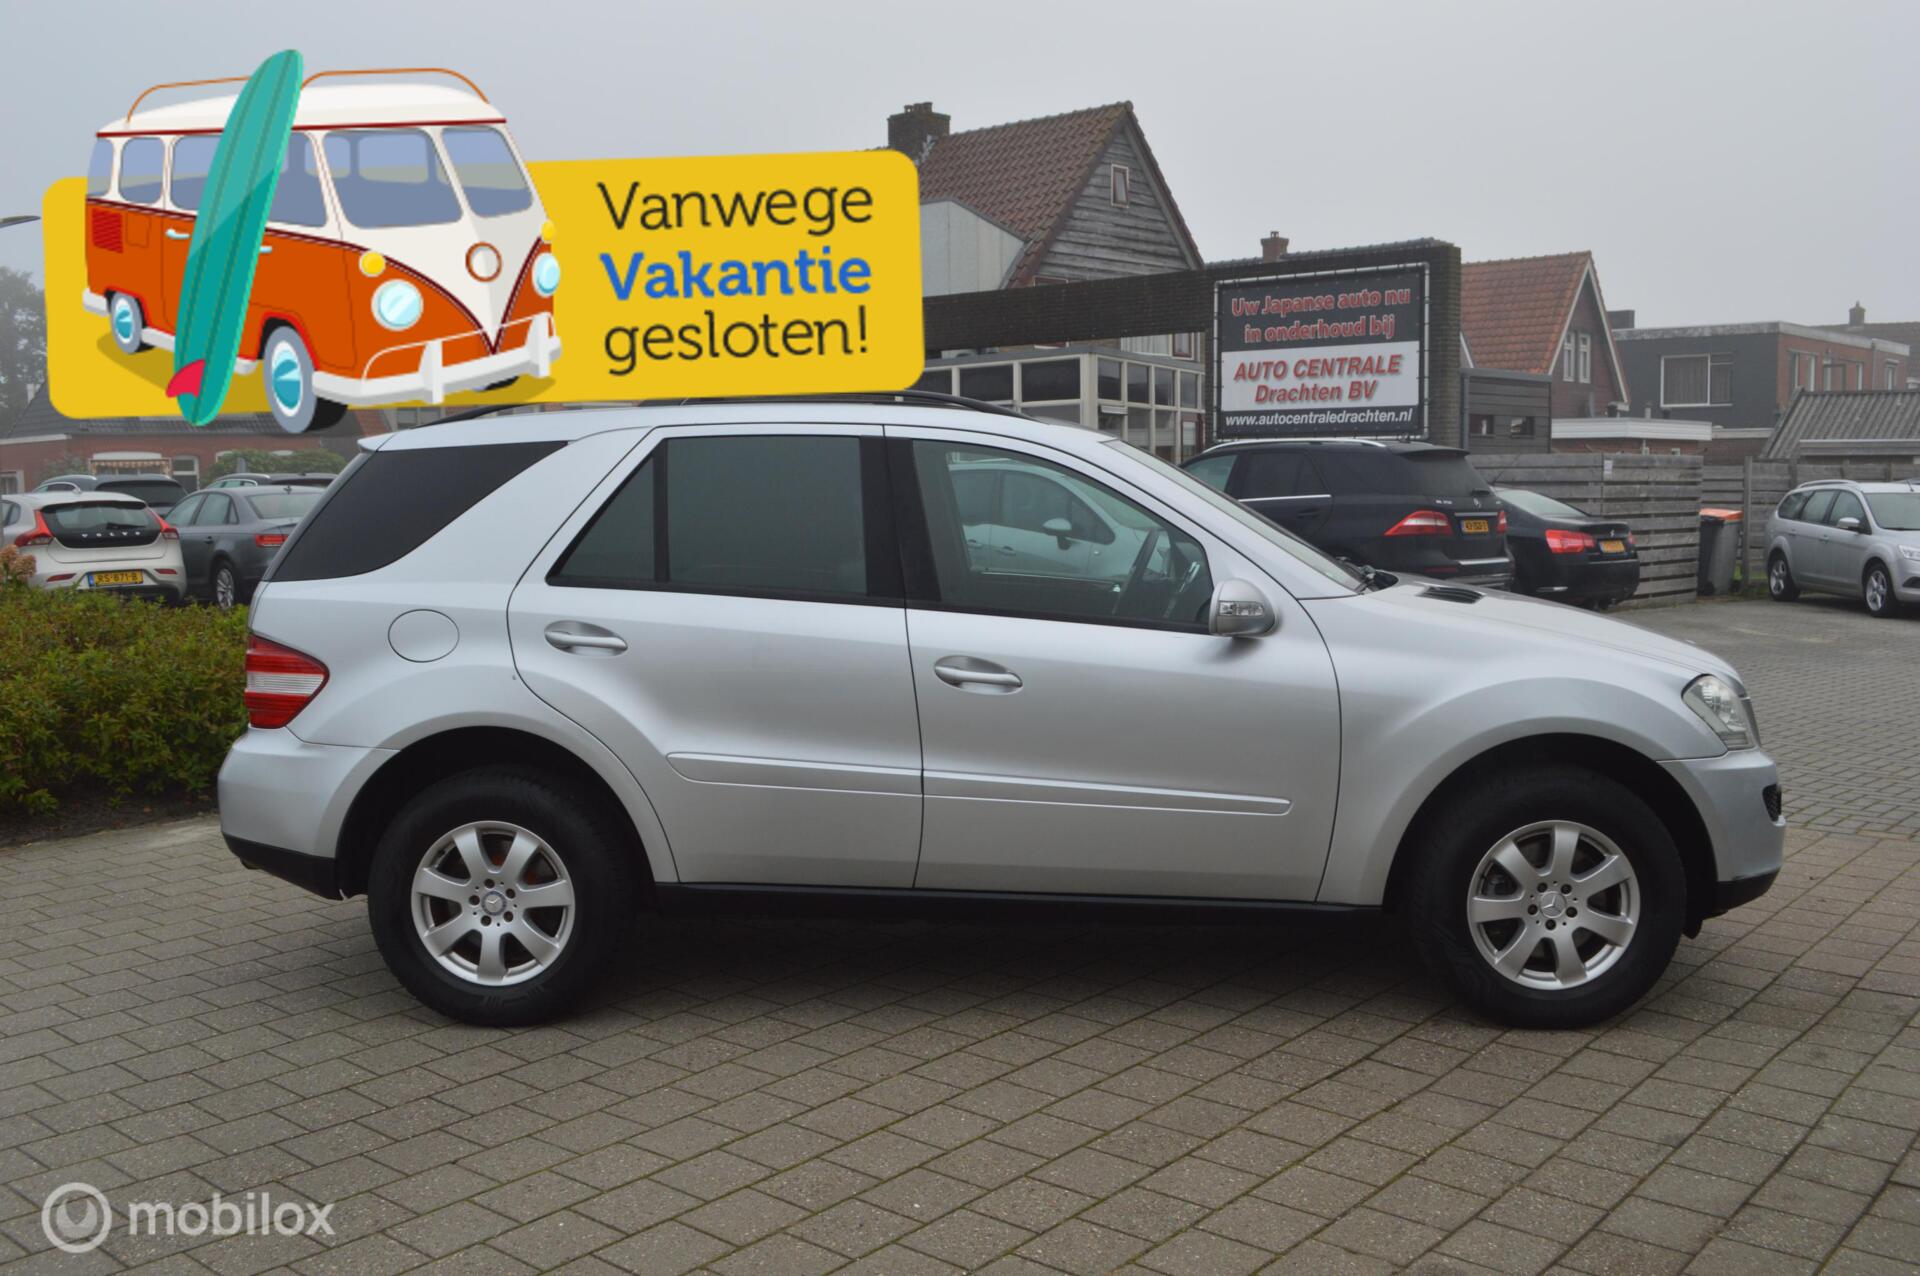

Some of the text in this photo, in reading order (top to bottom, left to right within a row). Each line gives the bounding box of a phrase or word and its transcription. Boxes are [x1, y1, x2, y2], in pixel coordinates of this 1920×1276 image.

[1231, 288, 1411, 317] Uw Japanse auto nu
[1244, 314, 1396, 343] in onderhoud bij
[1233, 354, 1402, 381] AUTO CENTRALE
[1255, 380, 1378, 403] Drachten BV
[1225, 408, 1413, 426] www.autocentraledrachten.nl
